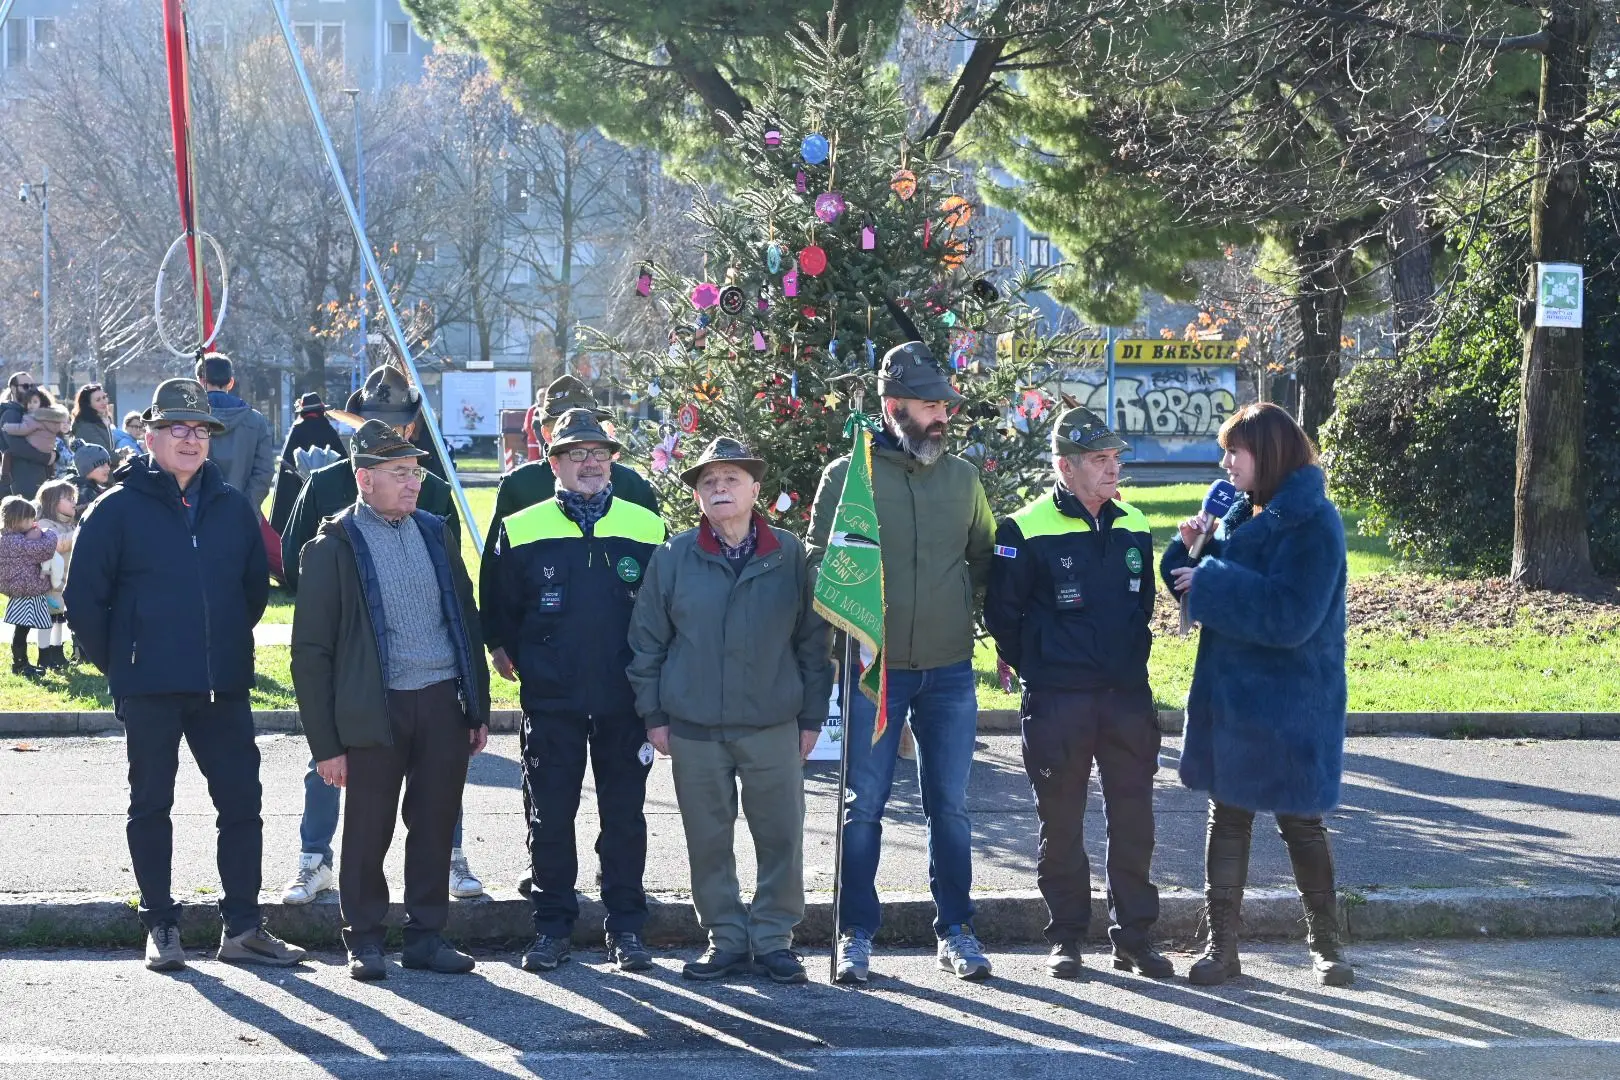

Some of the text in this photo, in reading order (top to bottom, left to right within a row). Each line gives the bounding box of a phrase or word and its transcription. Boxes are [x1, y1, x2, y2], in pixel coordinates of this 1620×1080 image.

[1018, 344, 1237, 359] GIAL DI BRESCIA
[823, 585, 882, 633] DI MOMPIA
